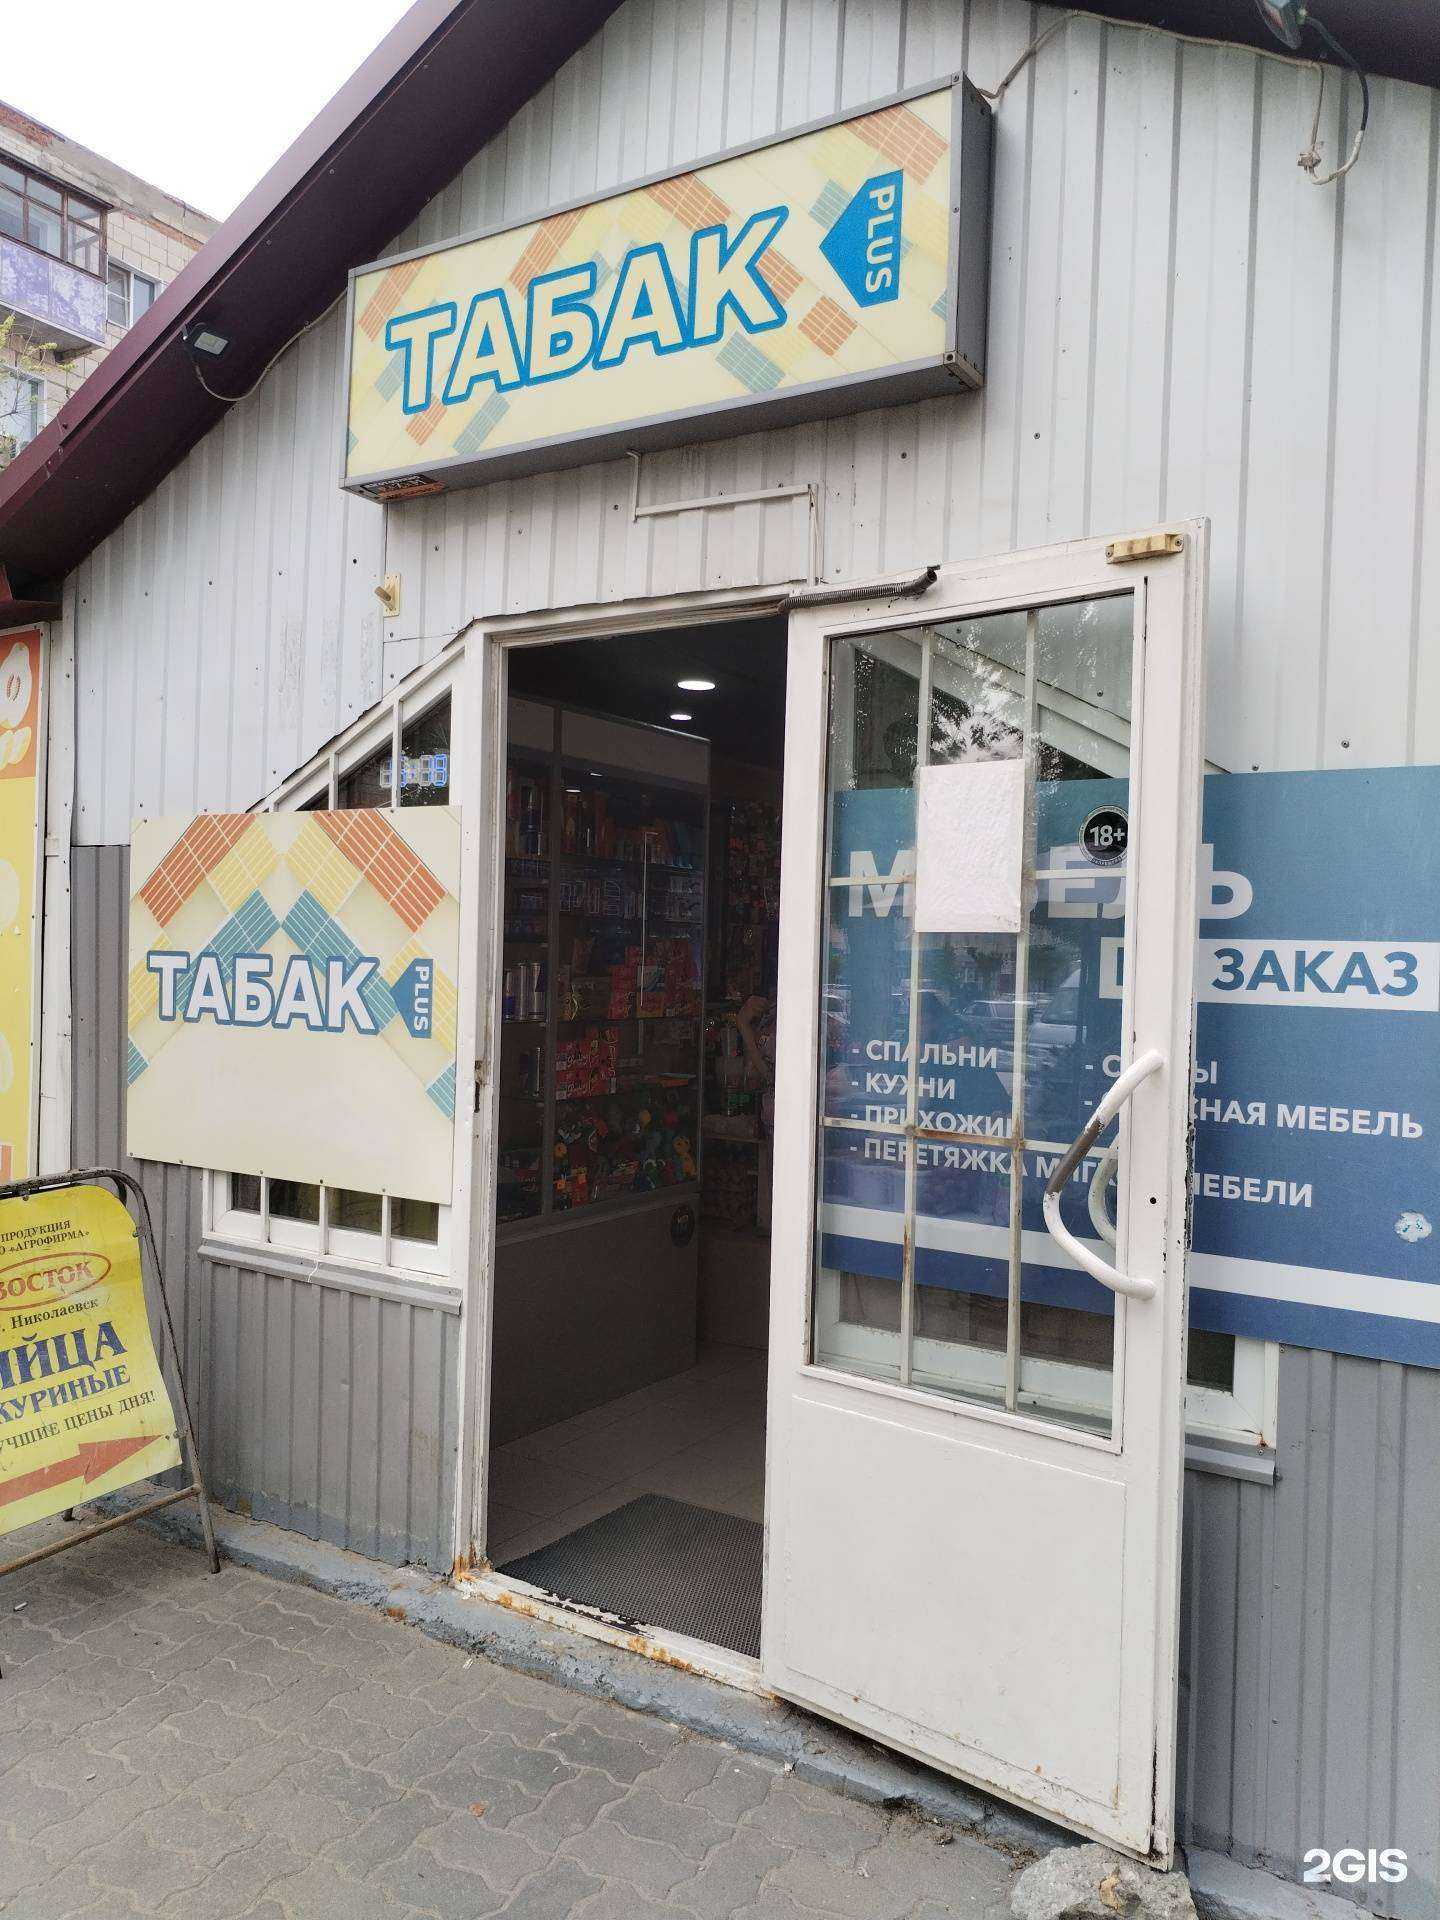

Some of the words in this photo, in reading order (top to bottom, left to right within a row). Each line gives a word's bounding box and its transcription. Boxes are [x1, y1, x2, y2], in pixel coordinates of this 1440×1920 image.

[866, 184, 897, 293] PLUS
[386, 205, 789, 414] ТАБАК
[1089, 824, 1126, 847] 18+
[848, 843, 1253, 921] МЕЬ
[146, 949, 381, 1036] ТАБАК
[412, 965, 432, 1033] PLUS
[1211, 947, 1420, 997] ЗАКАЗ
[1276, 1103, 1423, 1139] МЕБЕЛЬ
[11, 1298, 99, 1330] Николаевск
[64, 1403, 114, 1431] ЦЕНЫ
[118, 1389, 156, 1415] ДНЯ!
